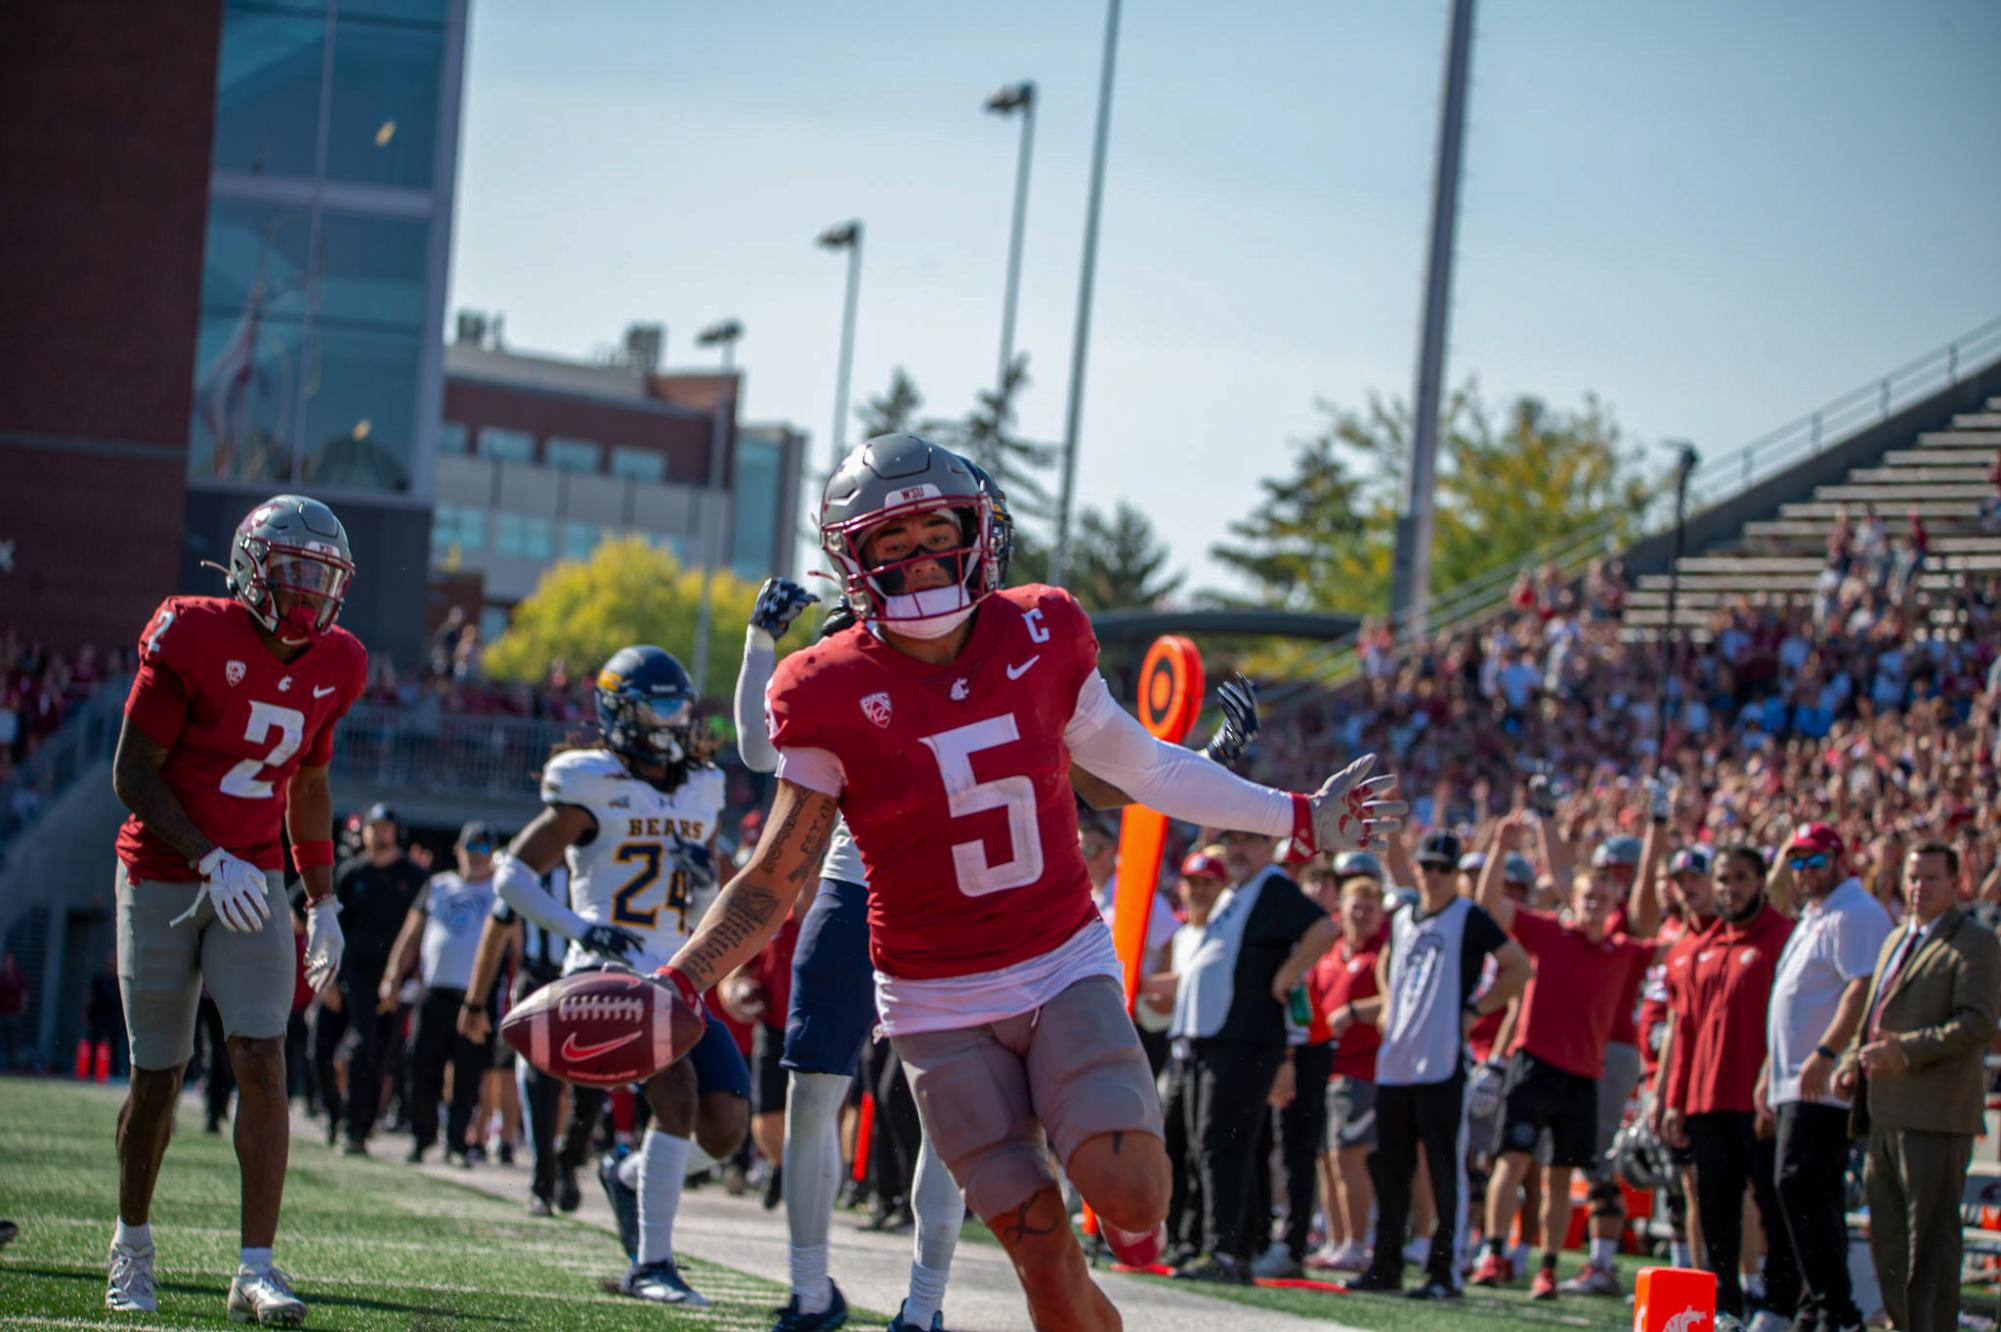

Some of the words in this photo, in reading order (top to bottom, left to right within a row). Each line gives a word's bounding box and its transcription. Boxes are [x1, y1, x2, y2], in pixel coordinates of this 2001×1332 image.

[901, 487, 925, 500] WSU
[148, 611, 174, 652] 2
[1021, 607, 1050, 643] C
[220, 699, 304, 798] 2
[917, 712, 1044, 897] 5
[626, 818, 704, 839] BEARS
[610, 841, 688, 935] 24
